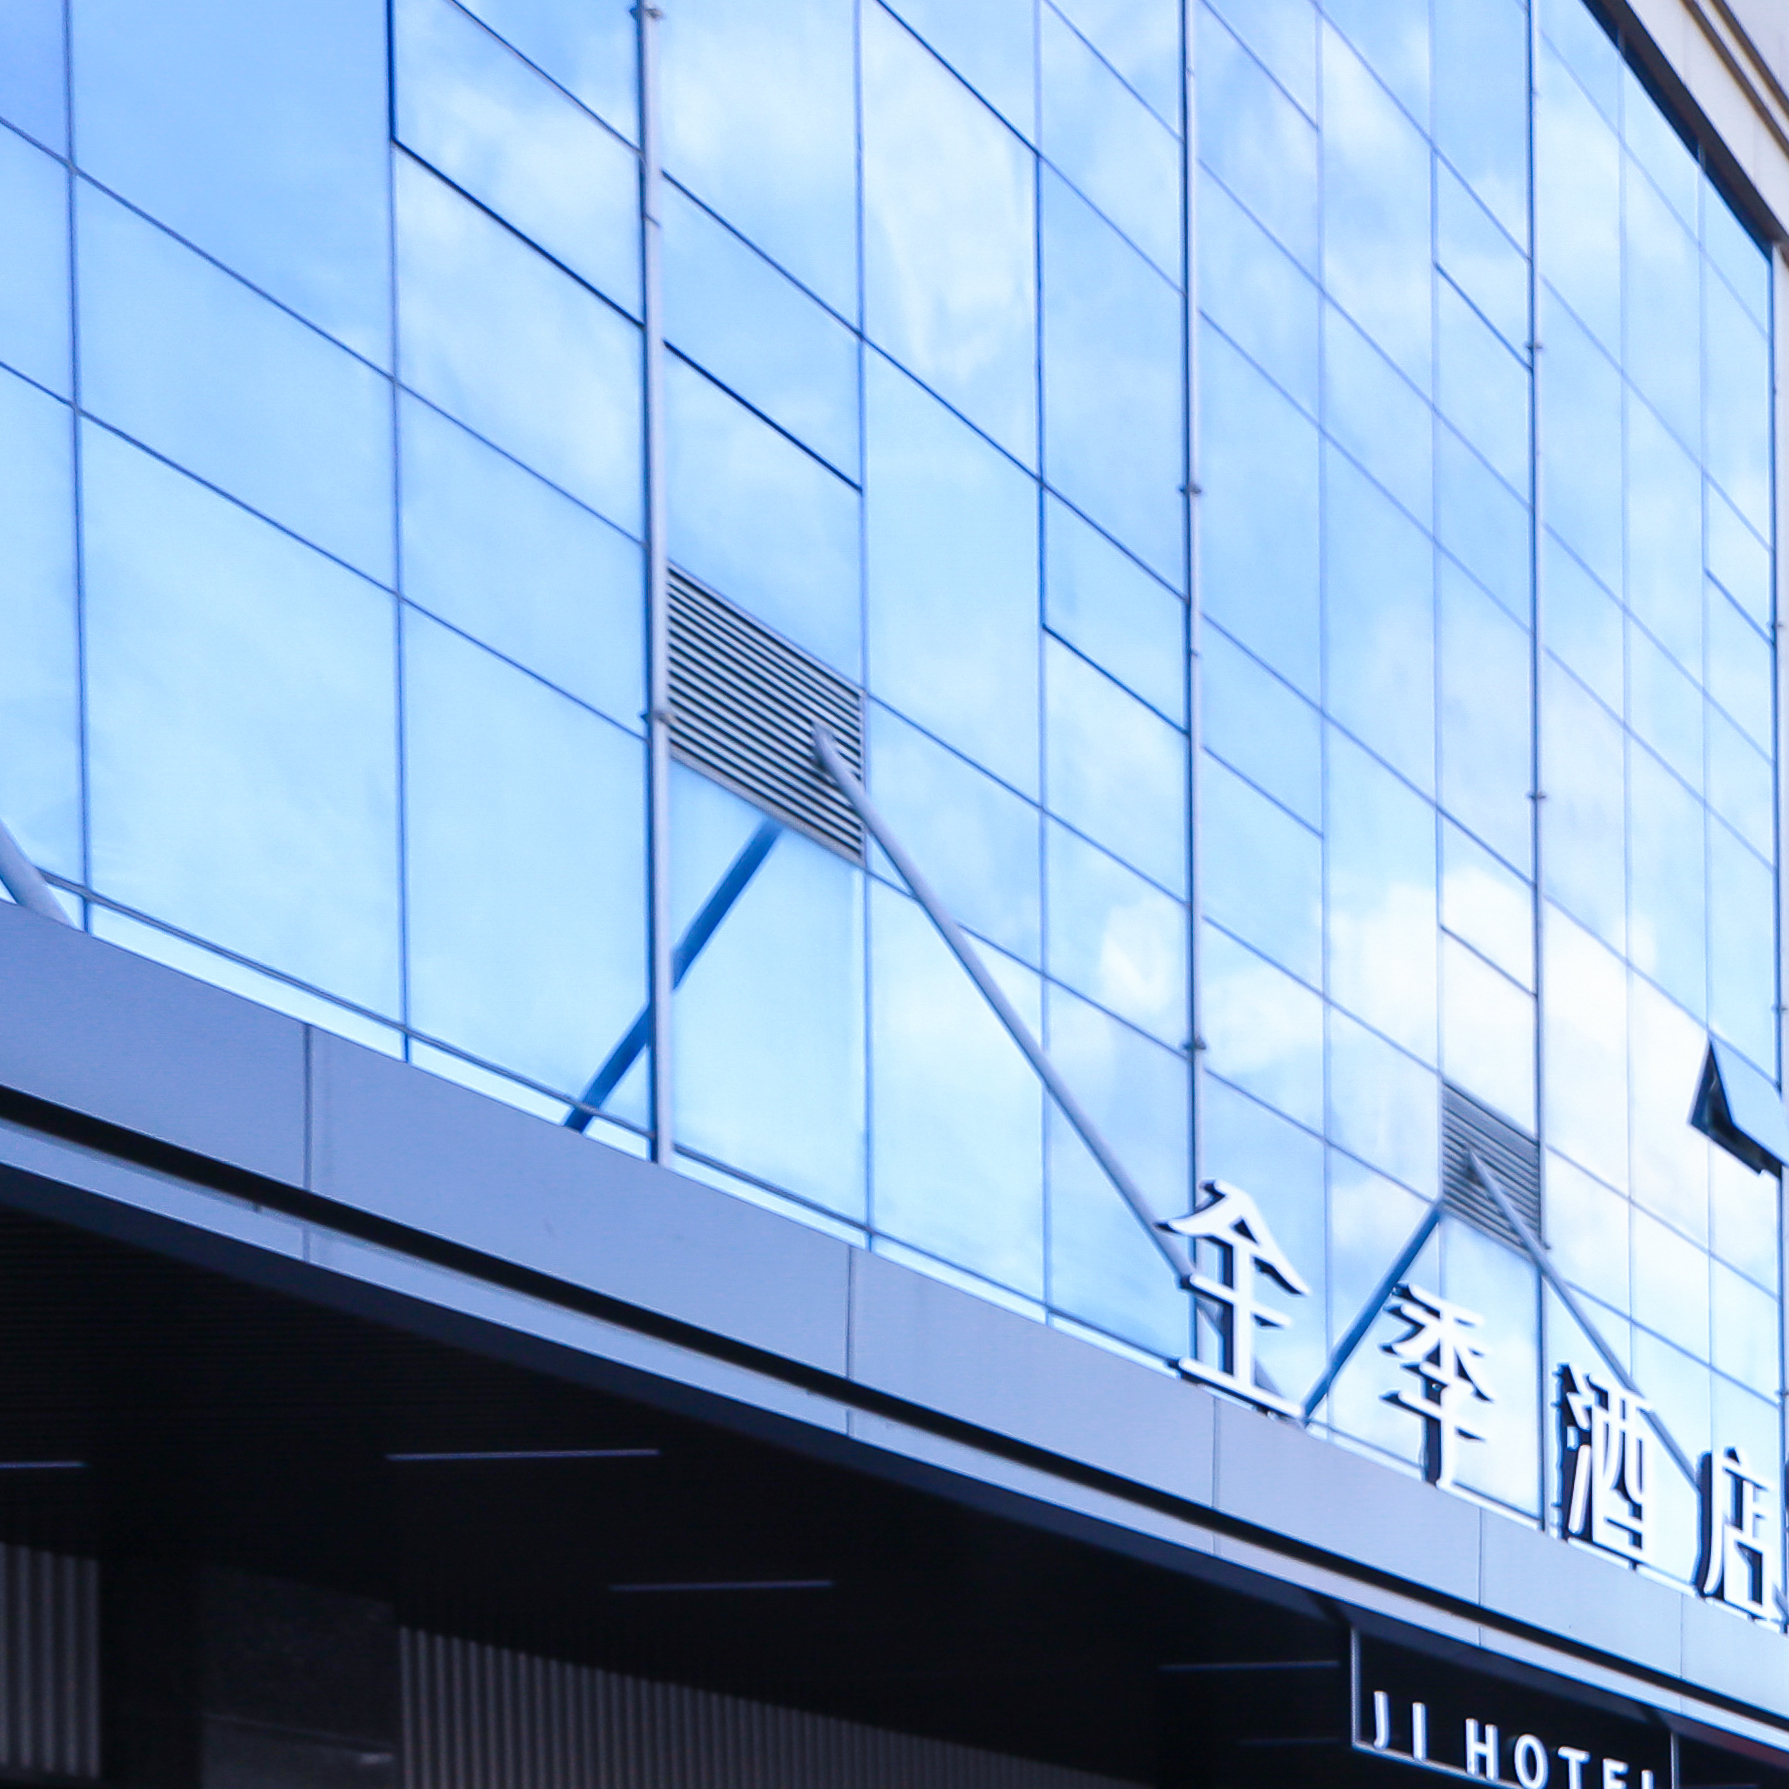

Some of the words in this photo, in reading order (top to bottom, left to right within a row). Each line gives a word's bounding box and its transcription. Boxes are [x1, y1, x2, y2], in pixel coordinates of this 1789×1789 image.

[1161, 1180, 1788, 1624] 全季酒店
[1373, 1690, 1428, 1760] JI
